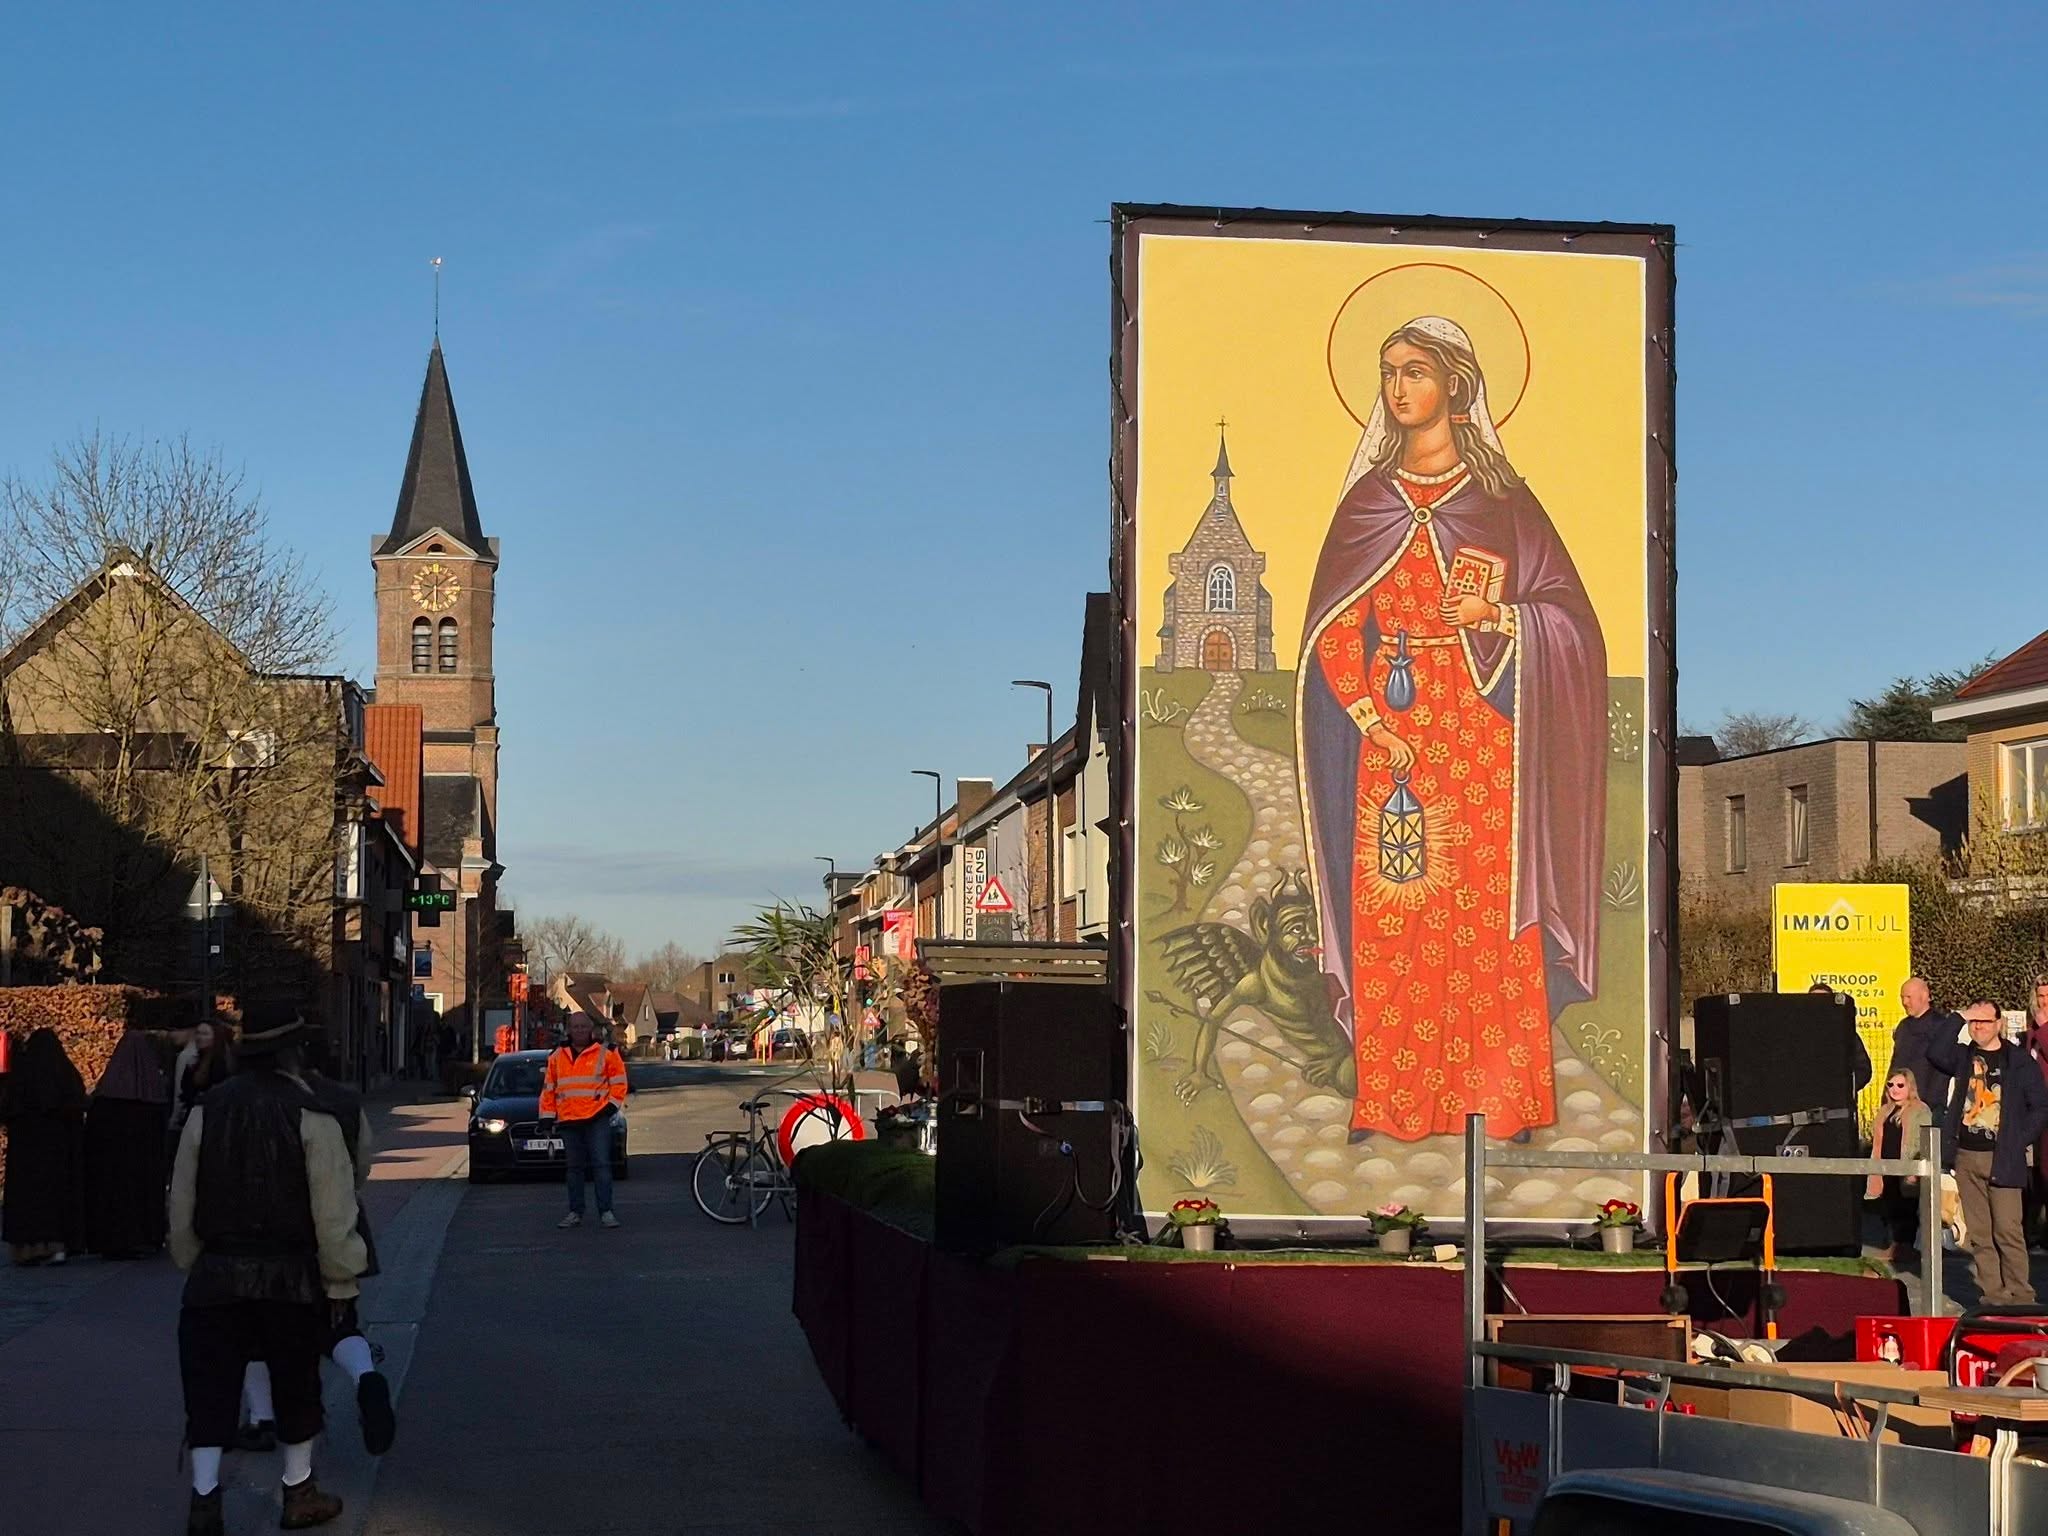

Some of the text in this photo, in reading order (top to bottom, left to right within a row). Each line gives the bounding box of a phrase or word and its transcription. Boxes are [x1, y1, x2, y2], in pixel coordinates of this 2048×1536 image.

[1811, 974, 1878, 985] VERKOOP
[1856, 988, 1870, 998] 26
[1873, 988, 1885, 998] 74
